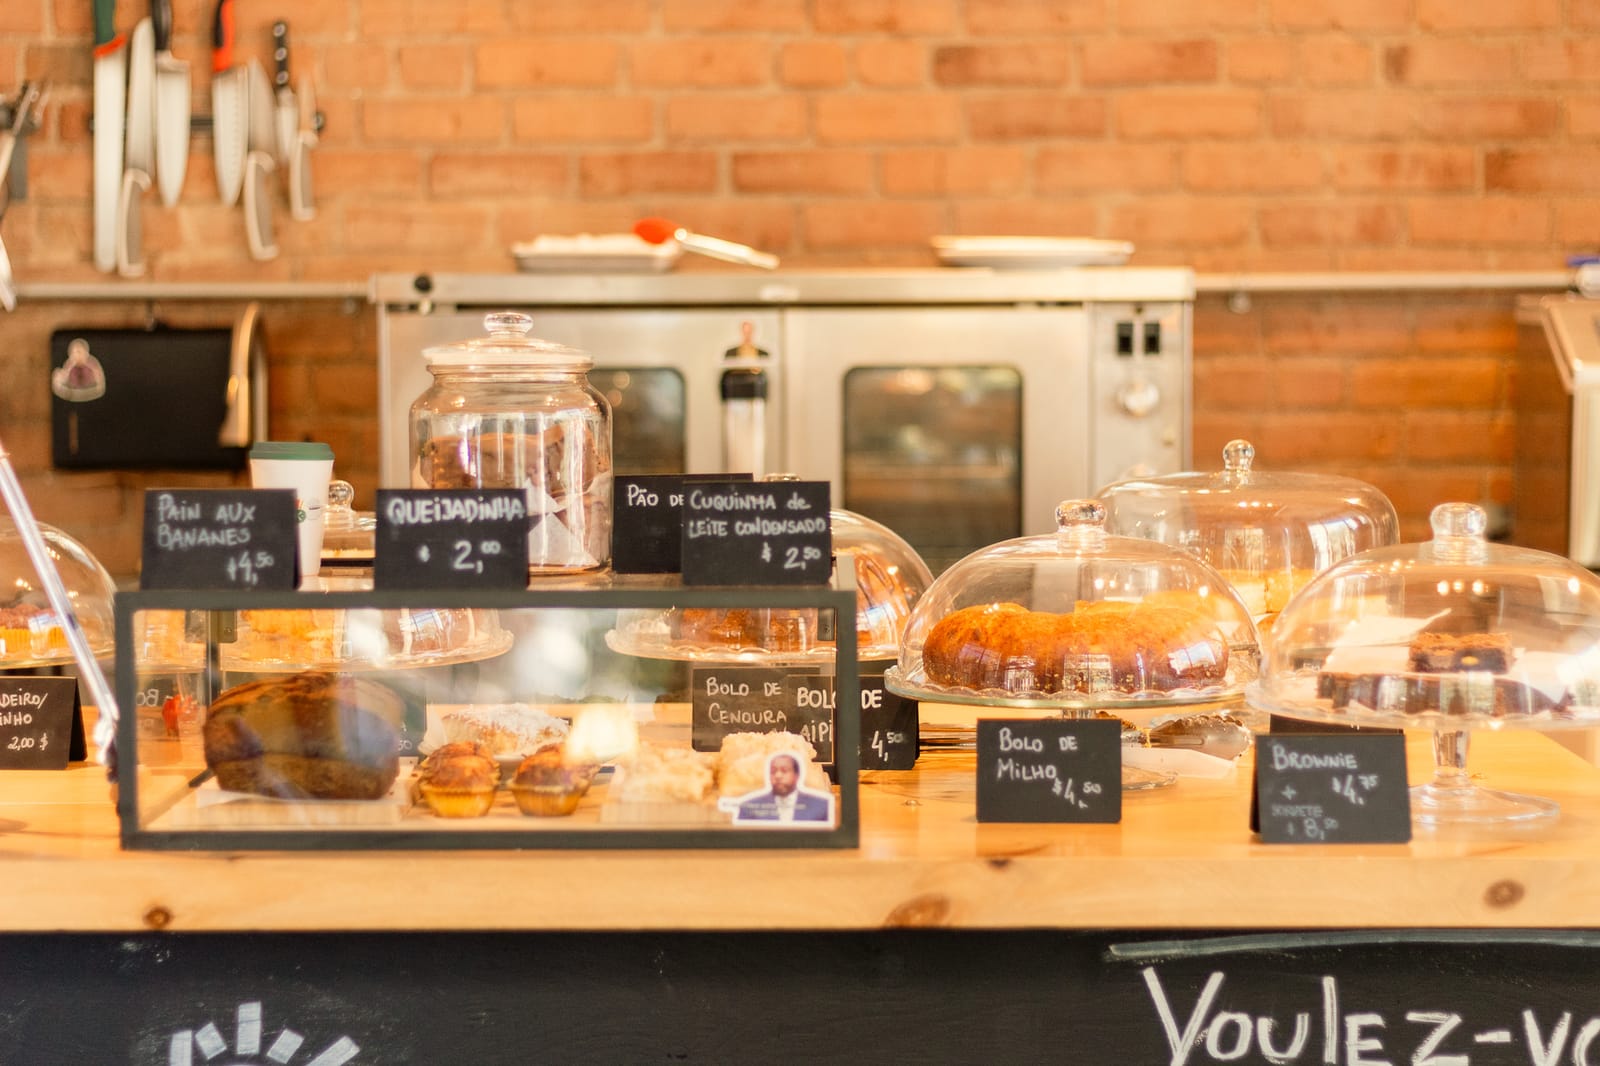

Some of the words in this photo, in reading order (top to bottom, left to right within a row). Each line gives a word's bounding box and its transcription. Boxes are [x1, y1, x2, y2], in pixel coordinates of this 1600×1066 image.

[627, 484, 659, 507] PÃO
[670, 493, 684, 506] DE
[216, 502, 256, 524] AUX
[158, 523, 251, 550] BANANES
[706, 676, 750, 697] BOLO
[764, 682, 782, 696] DE
[0, 688, 48, 709] DEiRO/
[861, 689, 882, 709] DE
[708, 702, 787, 725] CENOURA
[7, 736, 35, 751] 2,00
[40, 732, 49, 751] $
[999, 727, 1043, 752] BOLO
[1059, 735, 1078, 751] DE
